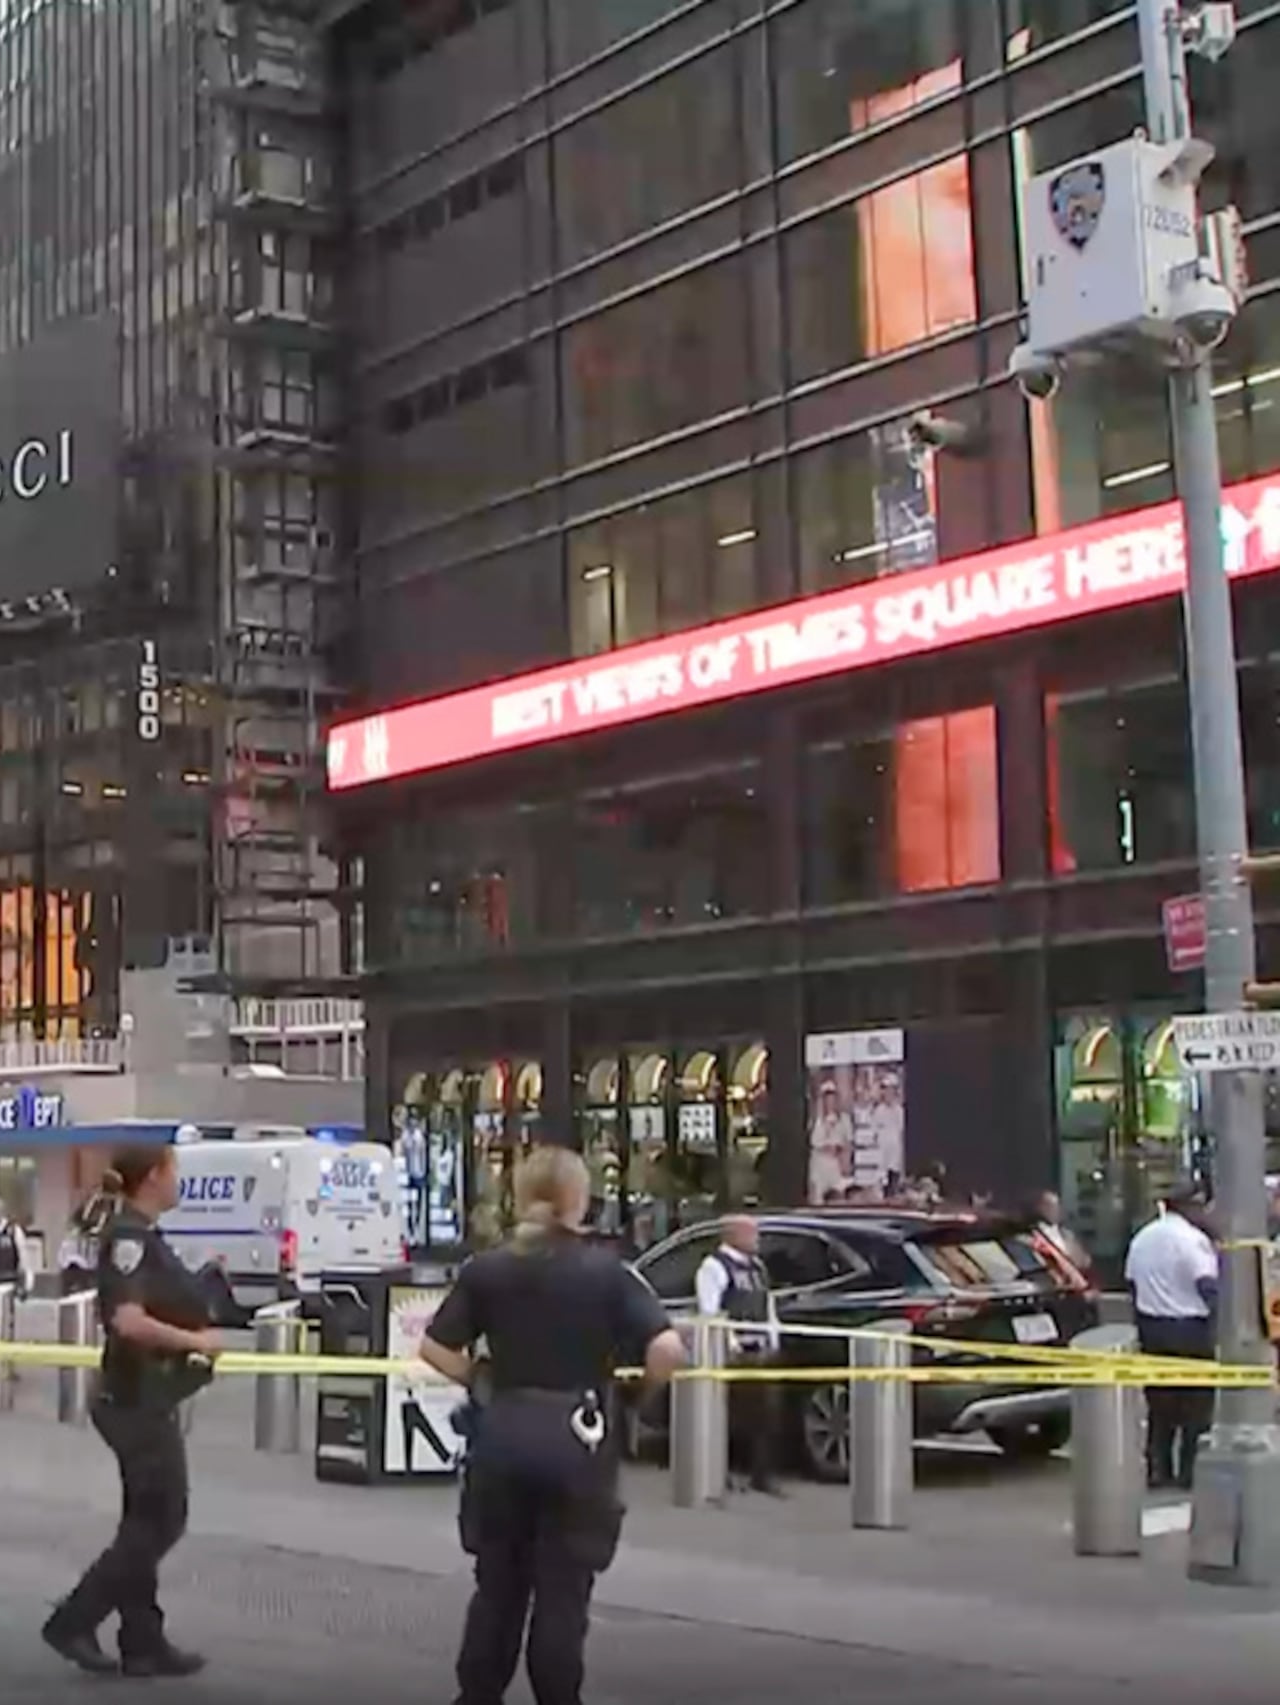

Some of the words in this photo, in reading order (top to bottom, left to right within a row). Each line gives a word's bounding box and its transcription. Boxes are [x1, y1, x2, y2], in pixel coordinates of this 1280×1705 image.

[139, 640, 159, 740] 1500
[573, 653, 685, 715] VIEWS
[688, 637, 739, 690] OF
[750, 604, 868, 673] TIMES
[874, 554, 1057, 642] SQUARE
[1064, 520, 1185, 597] HERE
